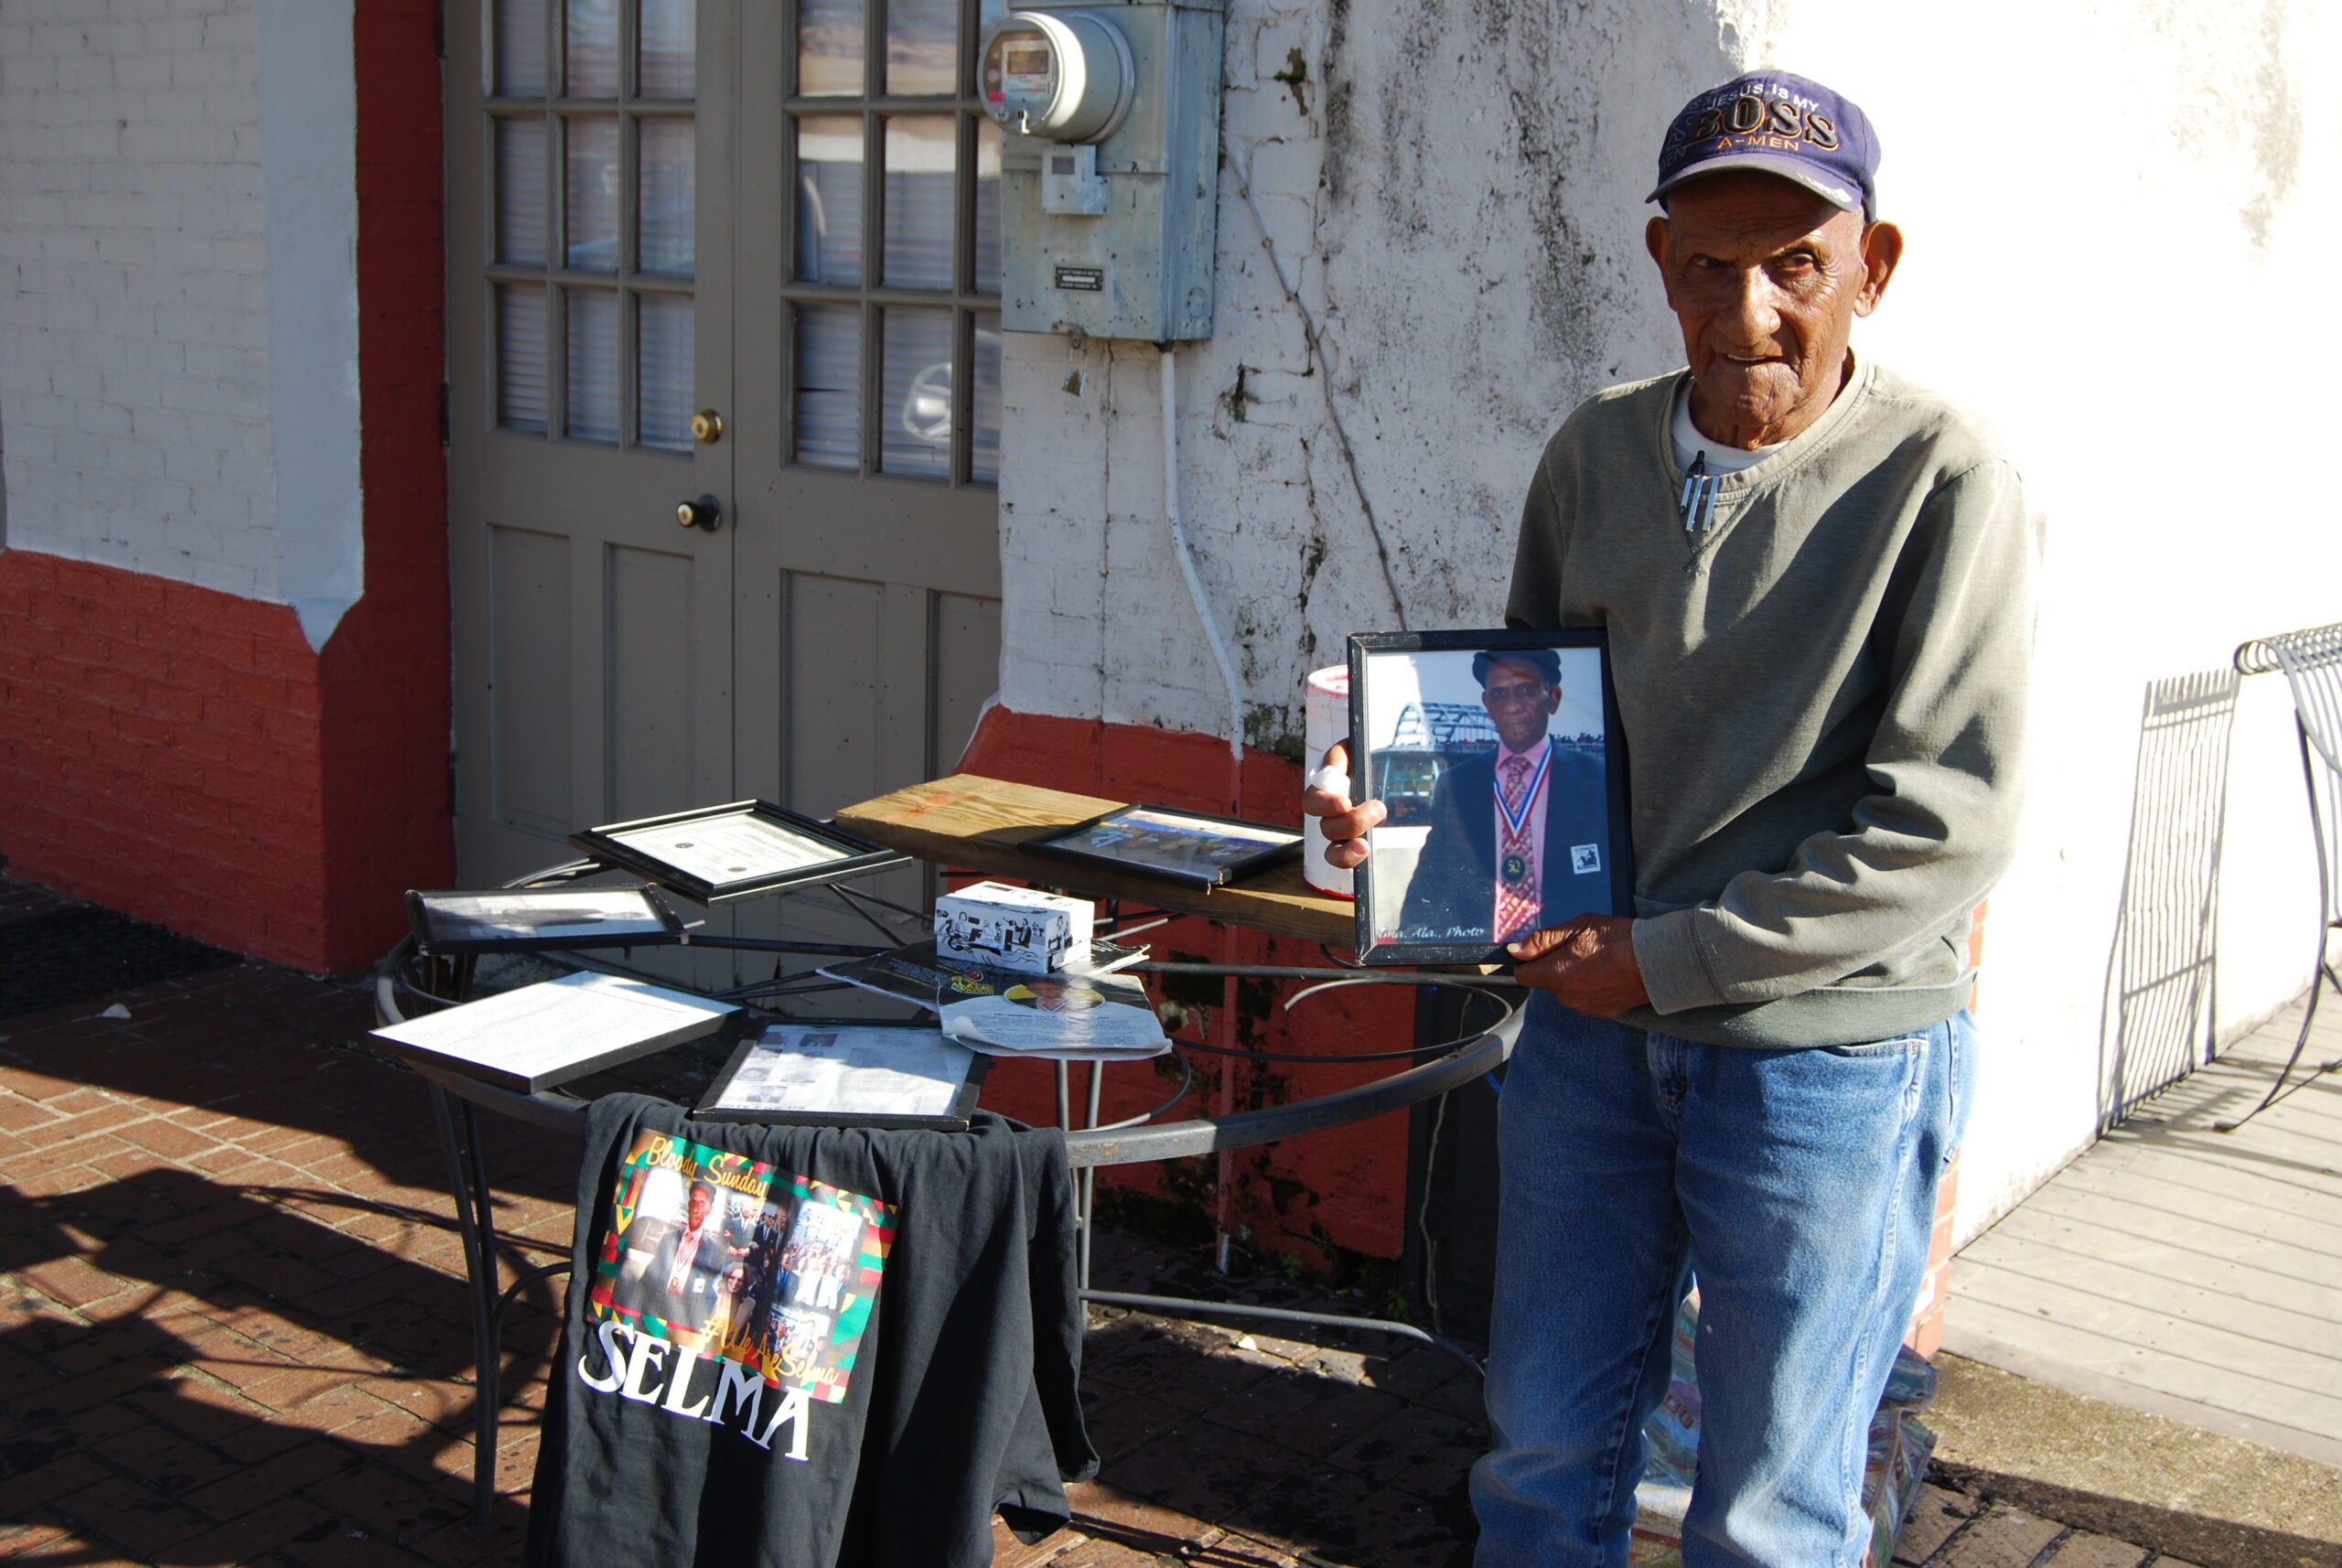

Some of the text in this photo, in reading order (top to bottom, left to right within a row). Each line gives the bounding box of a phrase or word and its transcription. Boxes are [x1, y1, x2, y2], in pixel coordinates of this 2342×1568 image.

[1707, 83, 1764, 110] JESUS
[1771, 83, 1789, 100] IS
[1793, 94, 1820, 112] MY
[1686, 95, 1839, 151] BOSS
[1717, 134, 1799, 151] A-MEN
[1446, 926, 1484, 938] Photo
[646, 1136, 768, 1201] Bloody Sunday
[777, 1342, 840, 1388] Selma
[577, 1320, 811, 1462] SELMA
